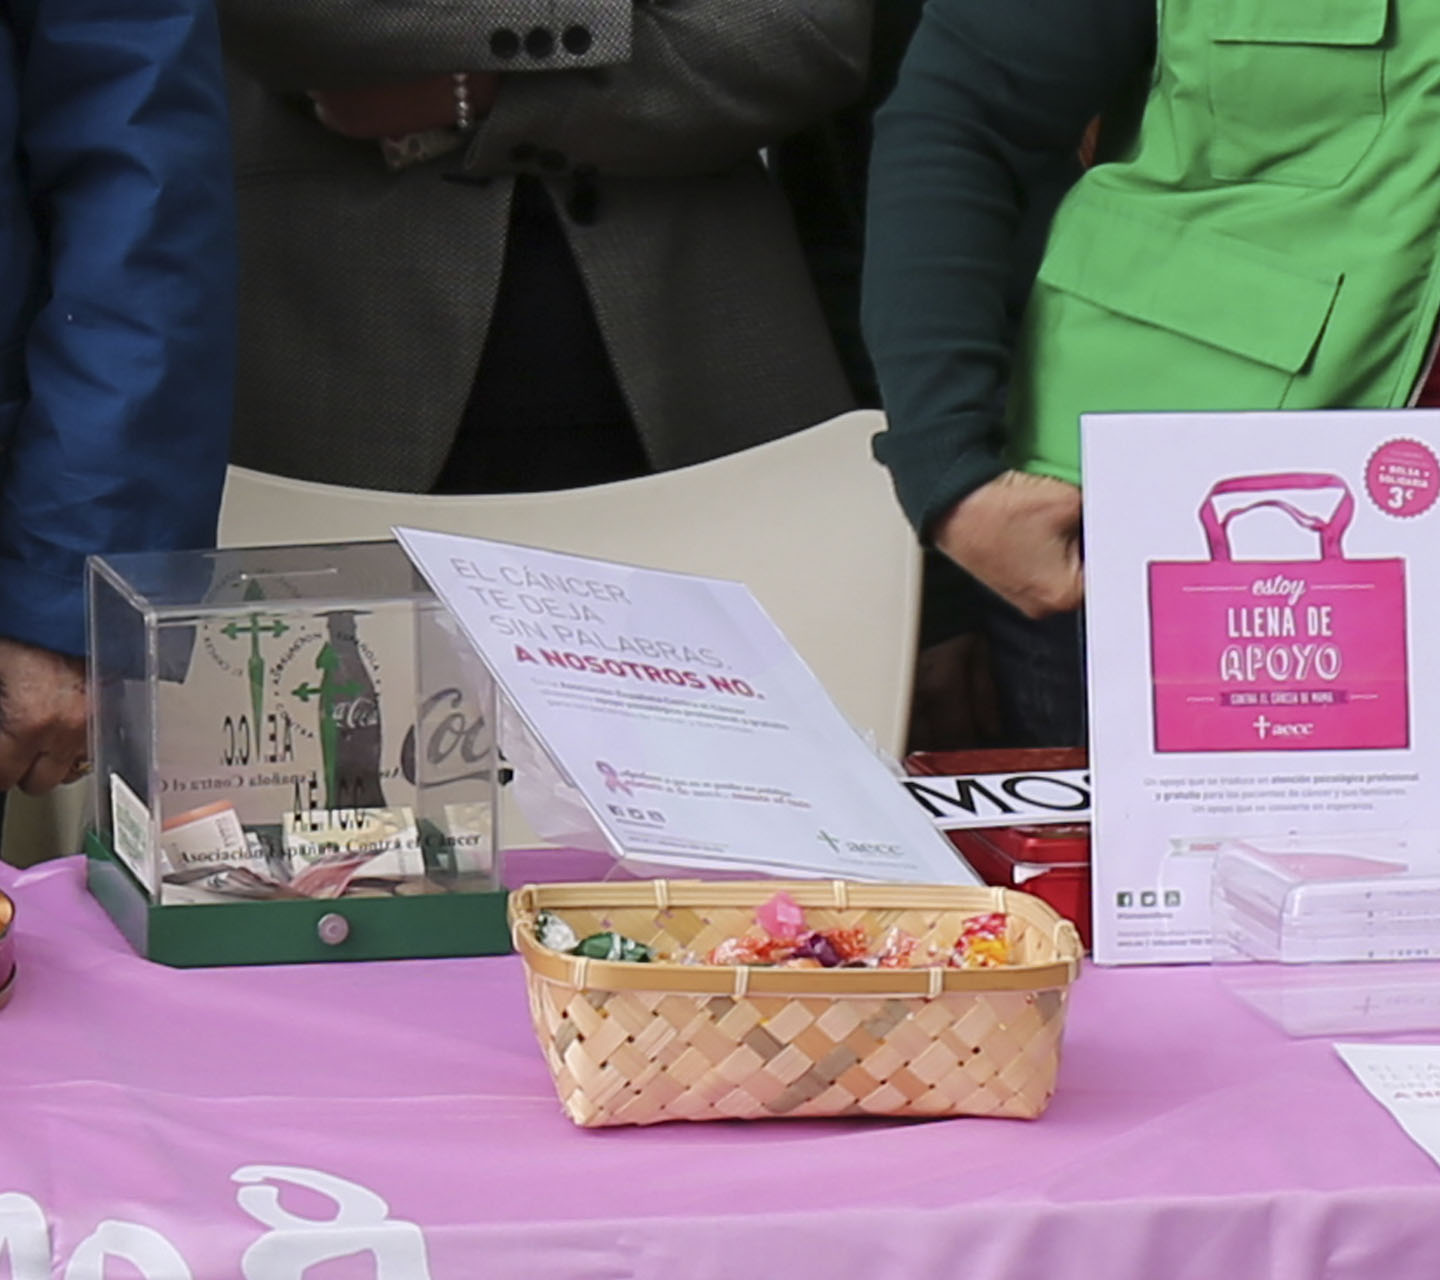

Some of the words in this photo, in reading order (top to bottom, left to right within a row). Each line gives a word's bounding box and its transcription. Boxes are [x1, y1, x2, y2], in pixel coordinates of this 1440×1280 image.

[449, 557, 497, 584] EL
[499, 564, 634, 606] CÁNCER
[1252, 575, 1306, 606] estoy
[469, 585, 515, 611] TE
[519, 594, 606, 625] DEJA
[1228, 606, 1296, 638] LLENA
[1307, 606, 1333, 637] DE
[489, 614, 548, 642] SIN
[551, 623, 733, 671] PALABRAS.
[514, 643, 539, 665] A
[539, 647, 707, 691] NOSOTROS
[707, 673, 767, 701] NO.
[1220, 643, 1342, 682] APOYO
[844, 840, 906, 857] aecc
